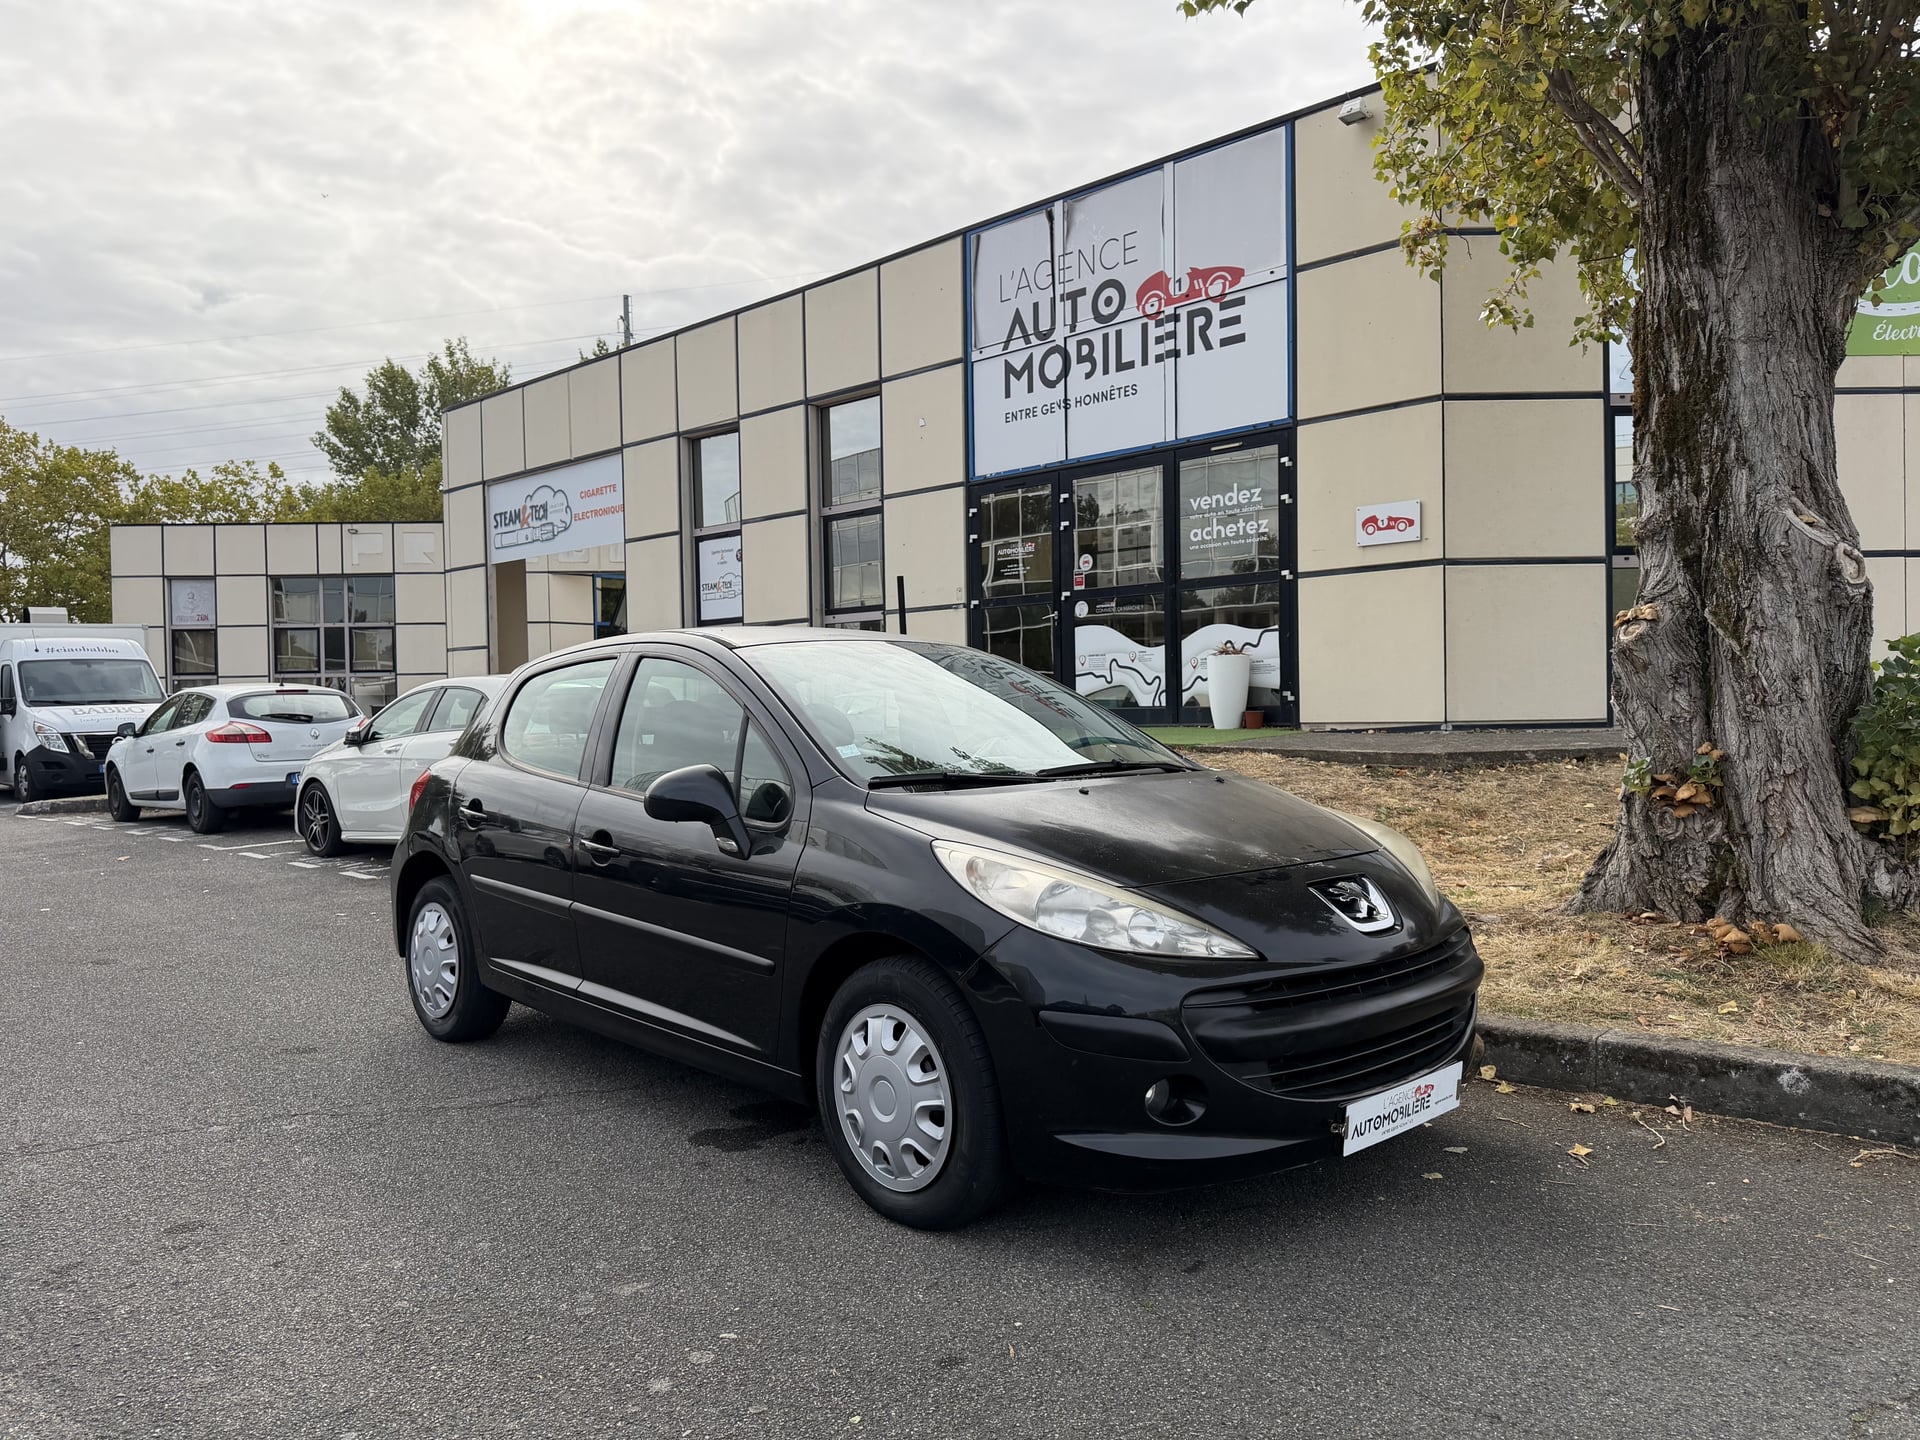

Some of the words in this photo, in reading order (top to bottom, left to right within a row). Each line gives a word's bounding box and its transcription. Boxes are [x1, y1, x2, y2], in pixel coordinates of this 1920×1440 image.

[999, 230, 1138, 303] L'AGENCE
[1002, 279, 1126, 351] AUTO
[1004, 295, 1246, 399] MOBILIERE
[1005, 406, 1038, 423] ENTRE
[1041, 398, 1072, 415] GENS
[1075, 384, 1138, 408] HONNÊTES
[580, 484, 617, 500] CIGARETTE
[1189, 483, 1262, 511] vendez
[574, 504, 624, 521] ELECTRONIQUE
[1189, 518, 1269, 541] achetez
[71, 705, 145, 716] BABBO
